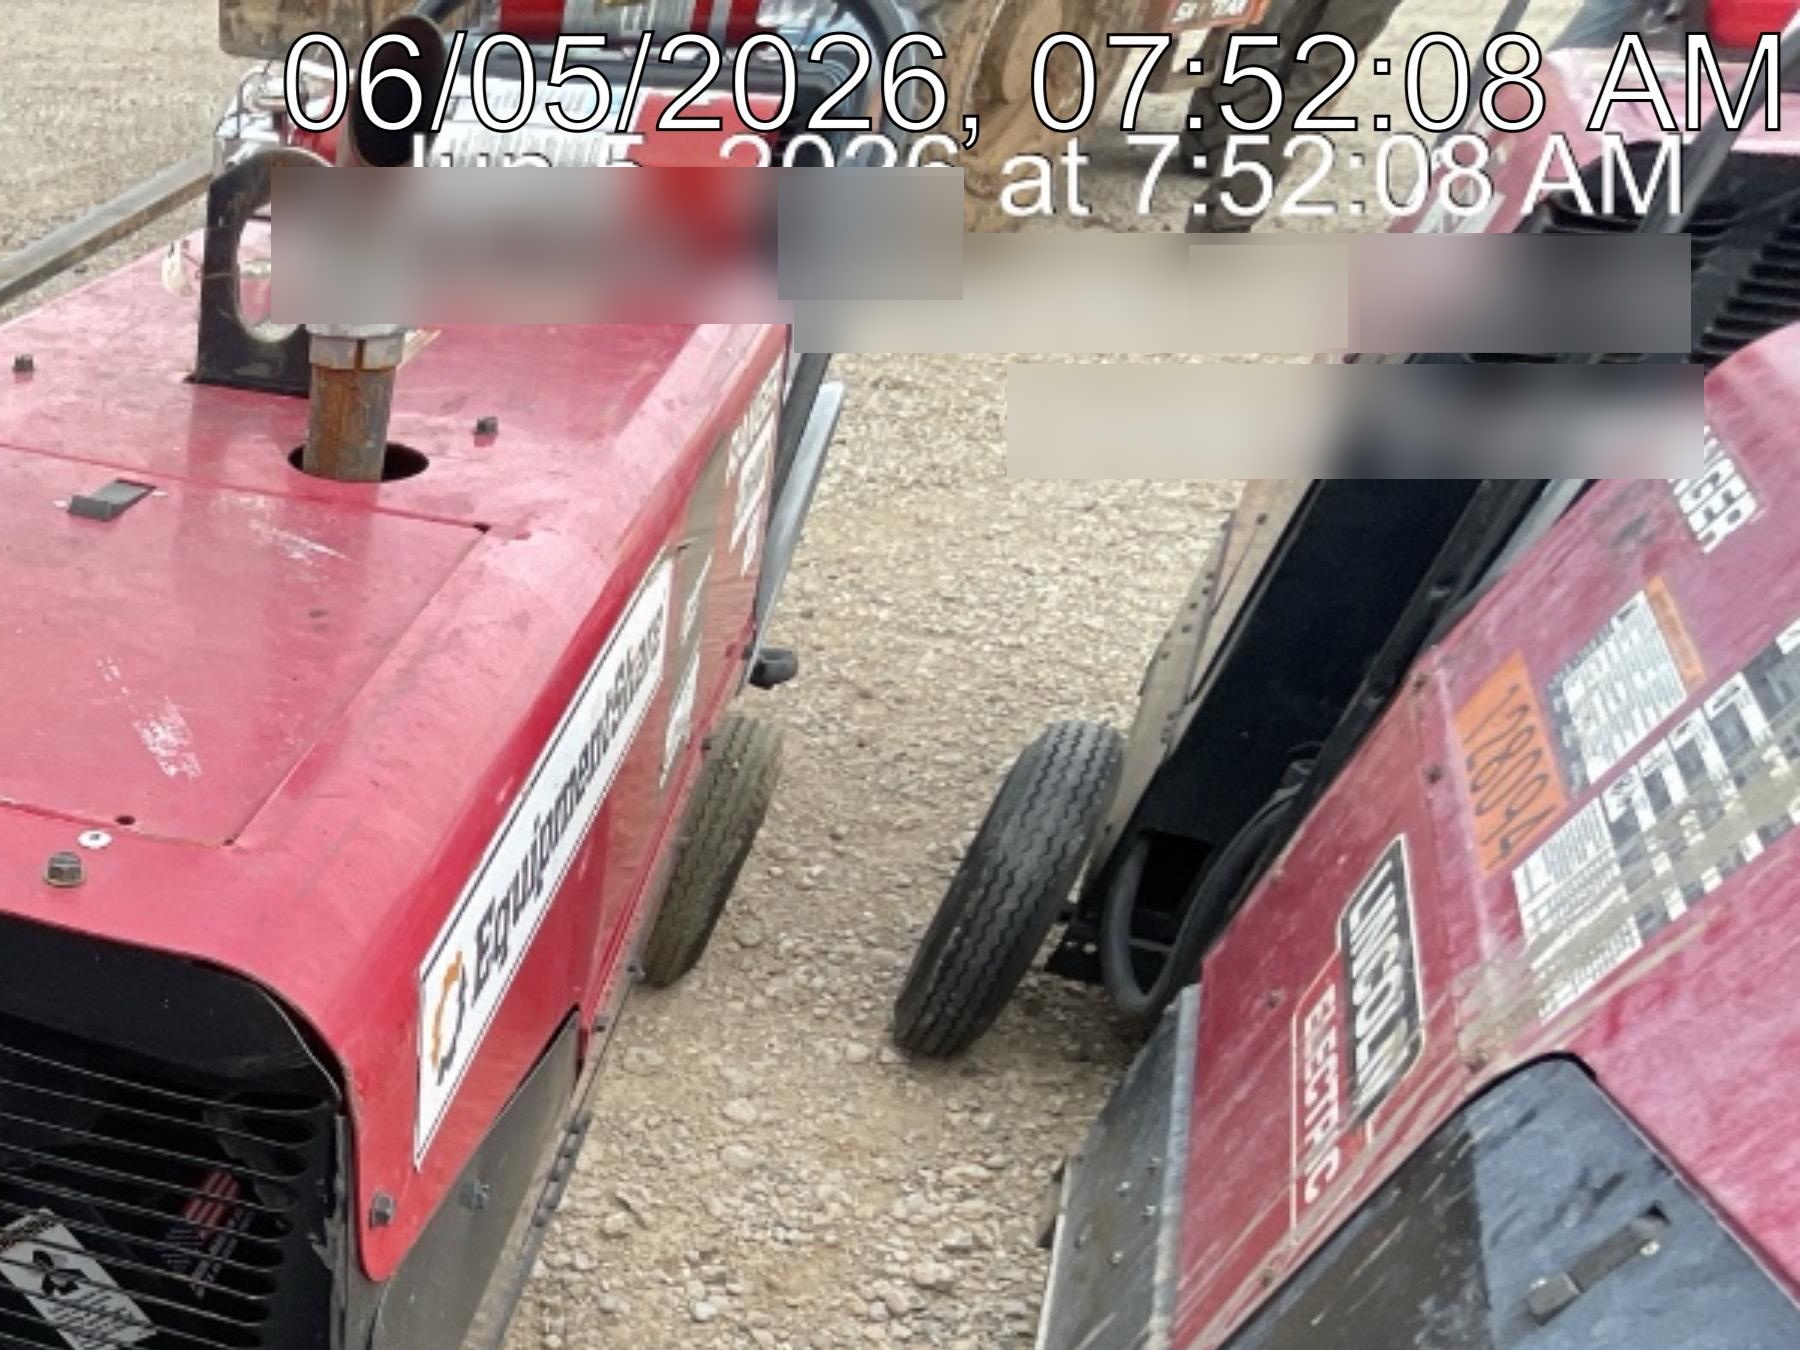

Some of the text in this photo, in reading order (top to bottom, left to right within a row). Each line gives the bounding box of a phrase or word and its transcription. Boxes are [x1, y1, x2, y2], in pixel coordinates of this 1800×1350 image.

[471, 604, 664, 1008] EquipmentShare
[1303, 982, 1340, 1204] ELECTRIC
[1348, 867, 1409, 1107] LINCOLN
